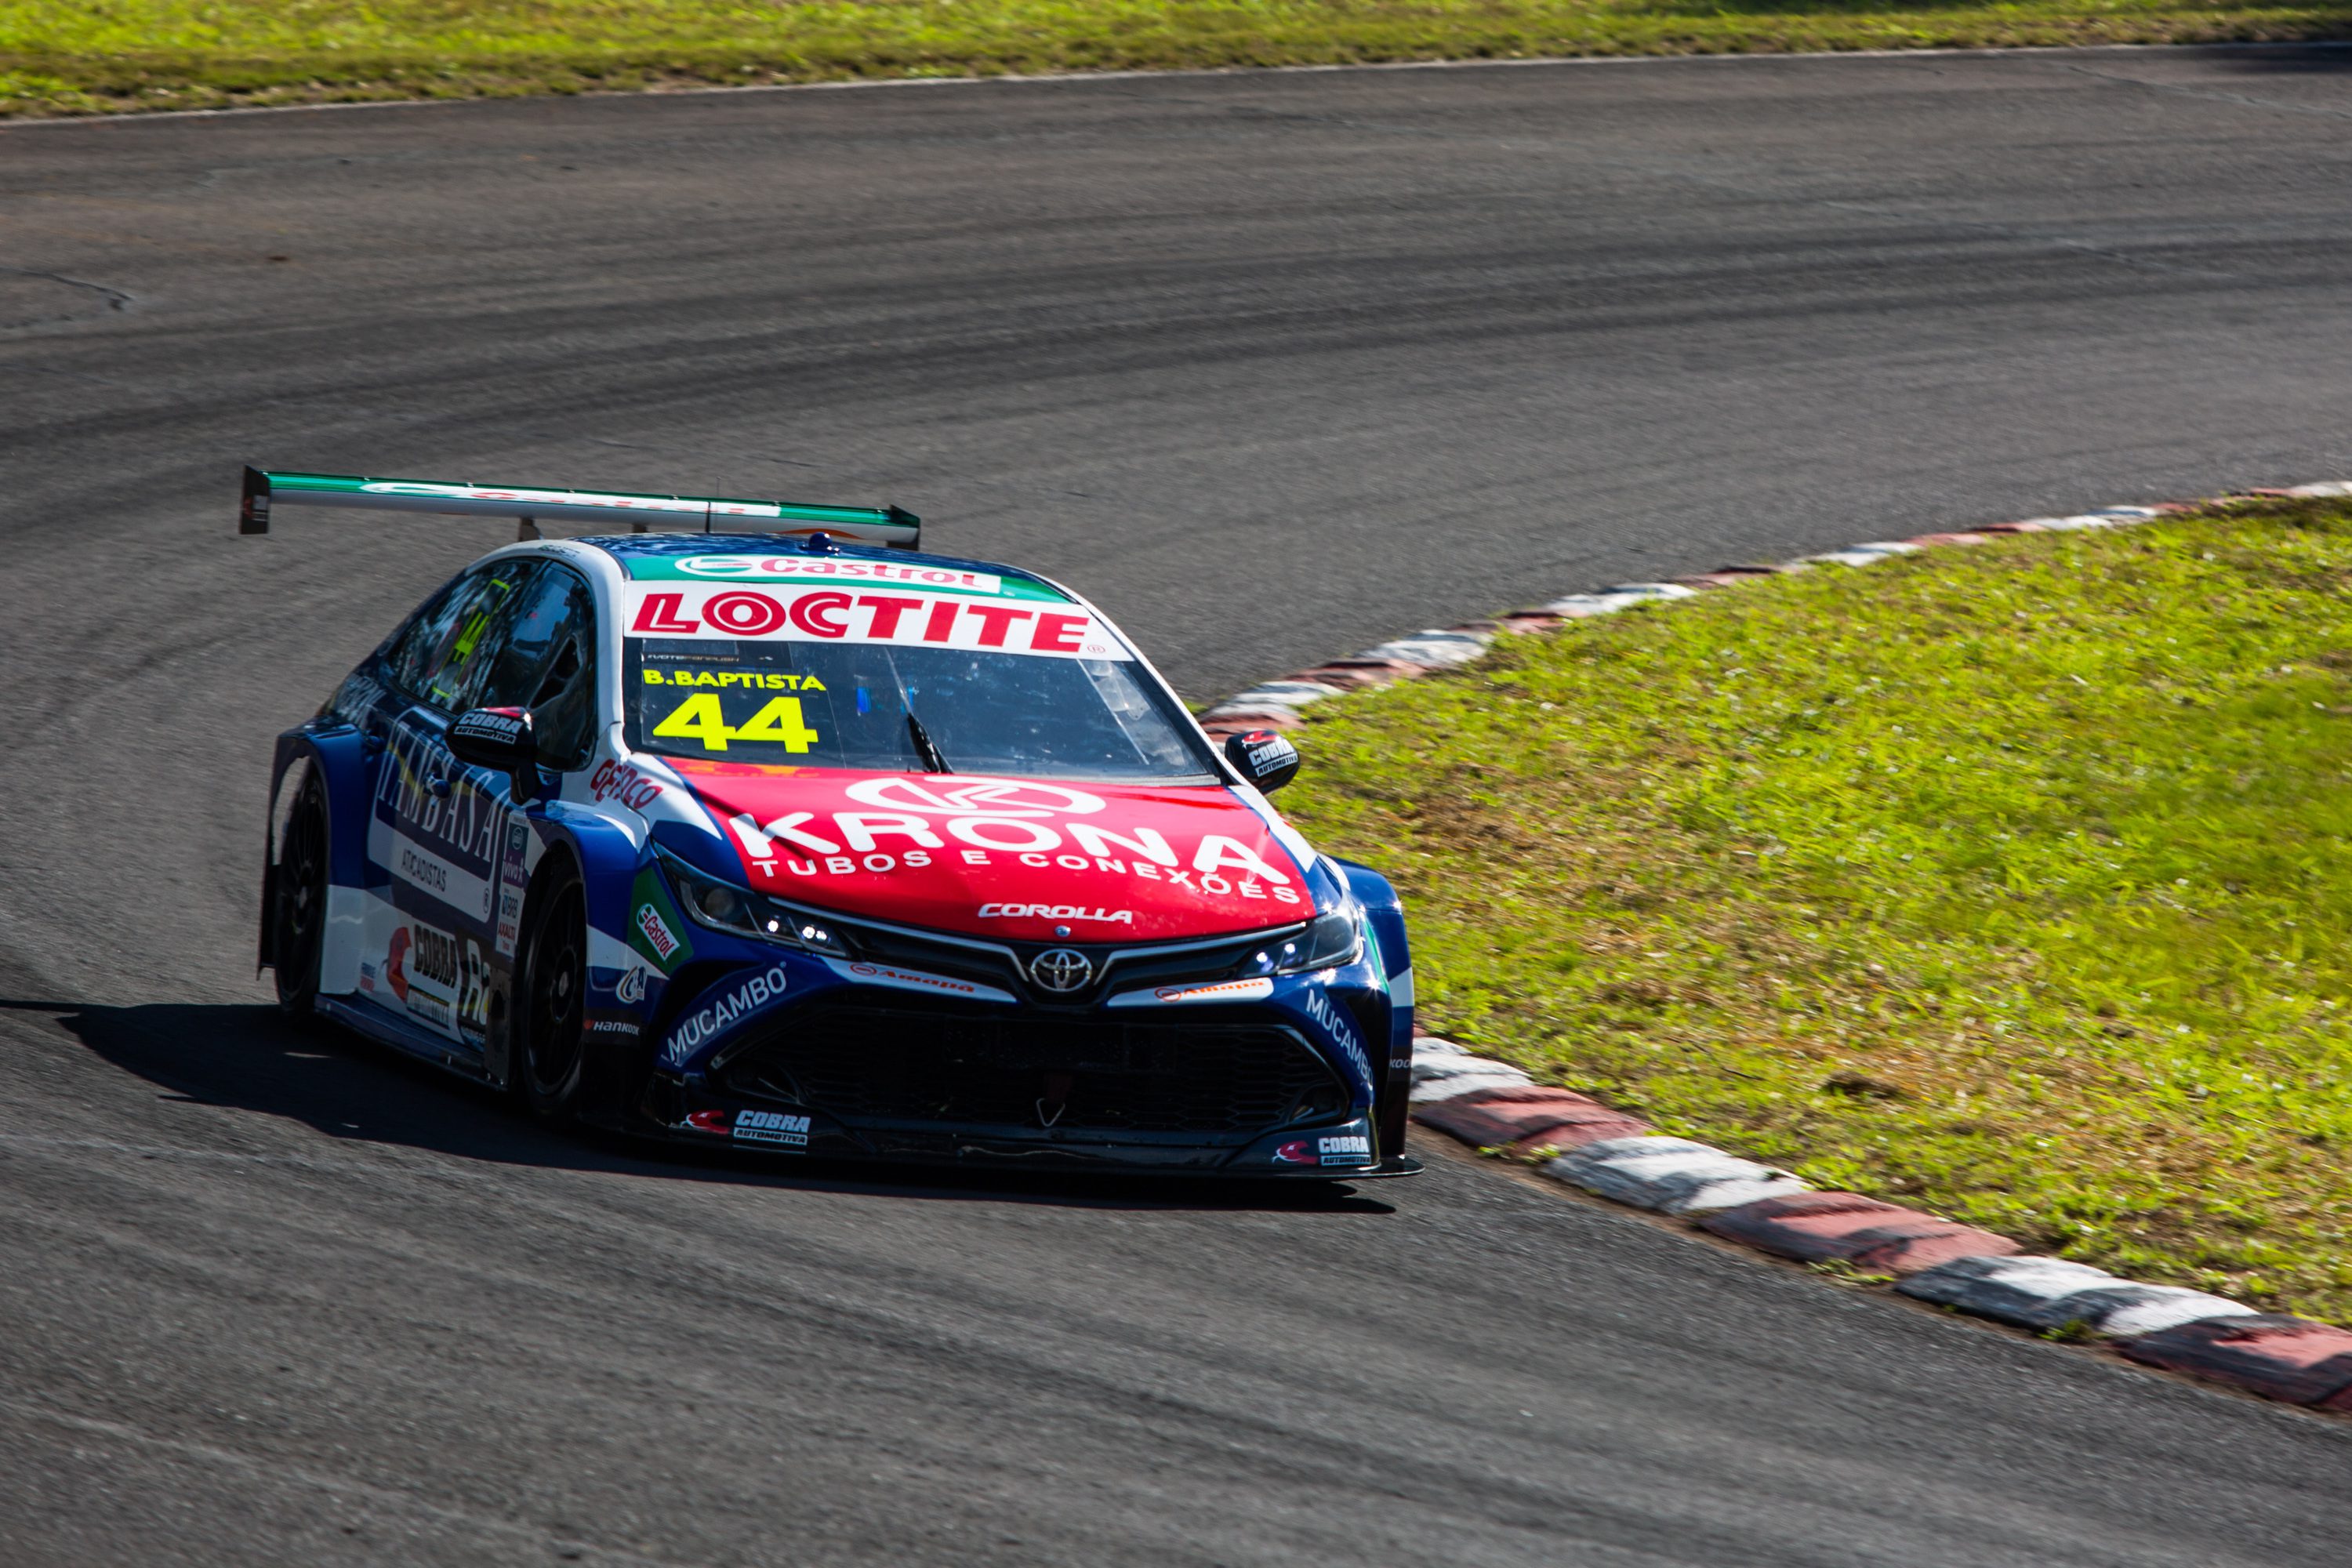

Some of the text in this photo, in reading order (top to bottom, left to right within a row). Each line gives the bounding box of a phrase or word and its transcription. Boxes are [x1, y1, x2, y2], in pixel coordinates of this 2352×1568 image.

[760, 557, 983, 588] Castrol
[631, 591, 1090, 653] LOCTITE
[643, 669, 827, 691] B.BAPTISTA
[456, 727, 514, 743] AUTOMOTIVA
[458, 713, 524, 735] COBRA
[652, 692, 818, 753] 44
[1248, 736, 1295, 767] COBRA
[1258, 755, 1298, 775] AUTOMOTIVA
[729, 811, 1290, 885] KRONA
[752, 850, 1301, 905] TUBOS E CONEXÕES
[978, 902, 1133, 924] COROLLA
[644, 915, 675, 957] Castrol
[412, 924, 459, 989] COBRA
[666, 967, 787, 1062] MUCAMBO
[1305, 988, 1374, 1091] MUCAMBO
[735, 1109, 811, 1134] COBRA
[735, 1128, 807, 1145] AUTOMOTIVA
[1318, 1137, 1370, 1154] COBRA
